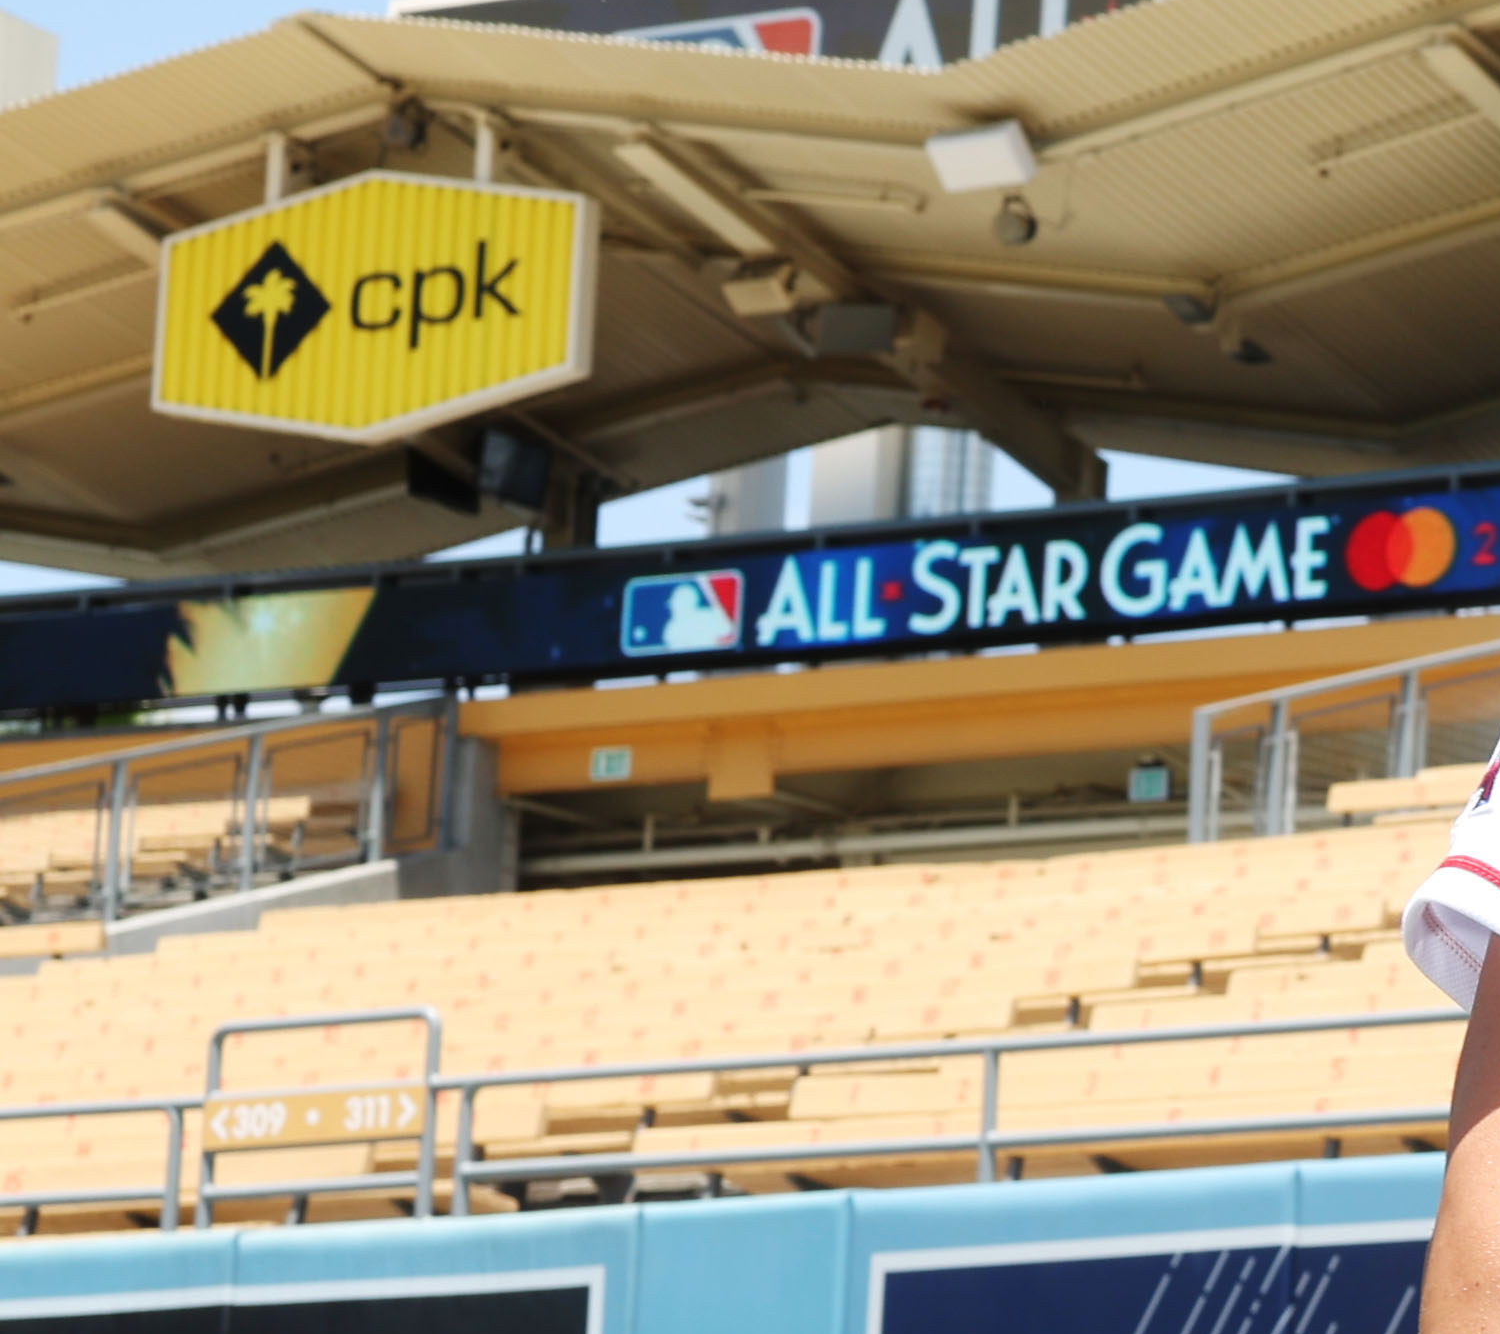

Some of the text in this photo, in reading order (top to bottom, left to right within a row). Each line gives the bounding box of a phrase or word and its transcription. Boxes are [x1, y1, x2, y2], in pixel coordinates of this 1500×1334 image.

[350, 239, 518, 351] cpk
[756, 555, 885, 646] ALL
[906, 539, 1089, 634] STAR
[1099, 515, 1329, 617] GAME
[230, 1094, 390, 1141] 309 311
